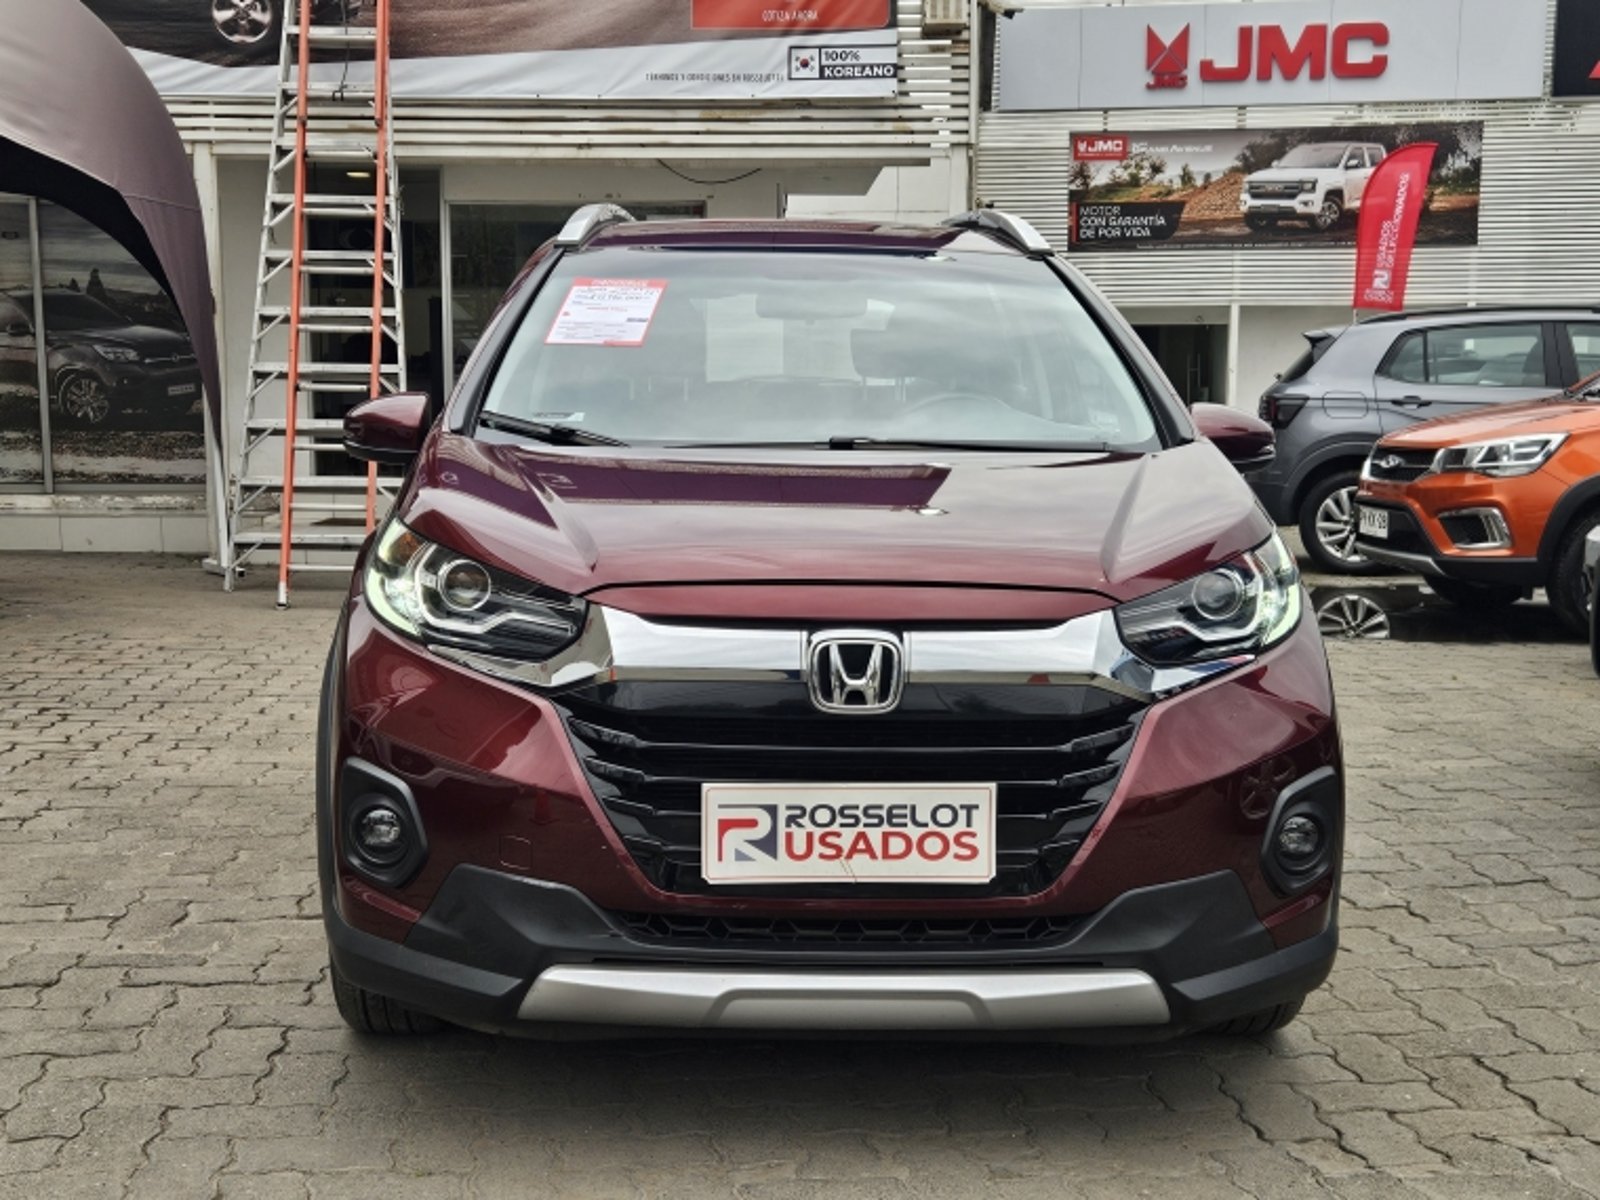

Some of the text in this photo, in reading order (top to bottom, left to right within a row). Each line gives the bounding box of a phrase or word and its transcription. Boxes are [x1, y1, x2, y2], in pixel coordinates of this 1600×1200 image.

[824, 50, 861, 61] 100%
[1200, 22, 1389, 81] JMC
[824, 65, 894, 77] KOREANO
[1088, 140, 1124, 152] JMC
[1080, 206, 1120, 216] MOTOR
[1080, 217, 1106, 226] CON
[1386, 172, 1410, 269] SELECCIONADOS
[1080, 227, 1151, 238] DE POR VIDA
[785, 804, 980, 829] ROSSELOT
[785, 831, 980, 862] USADOS
